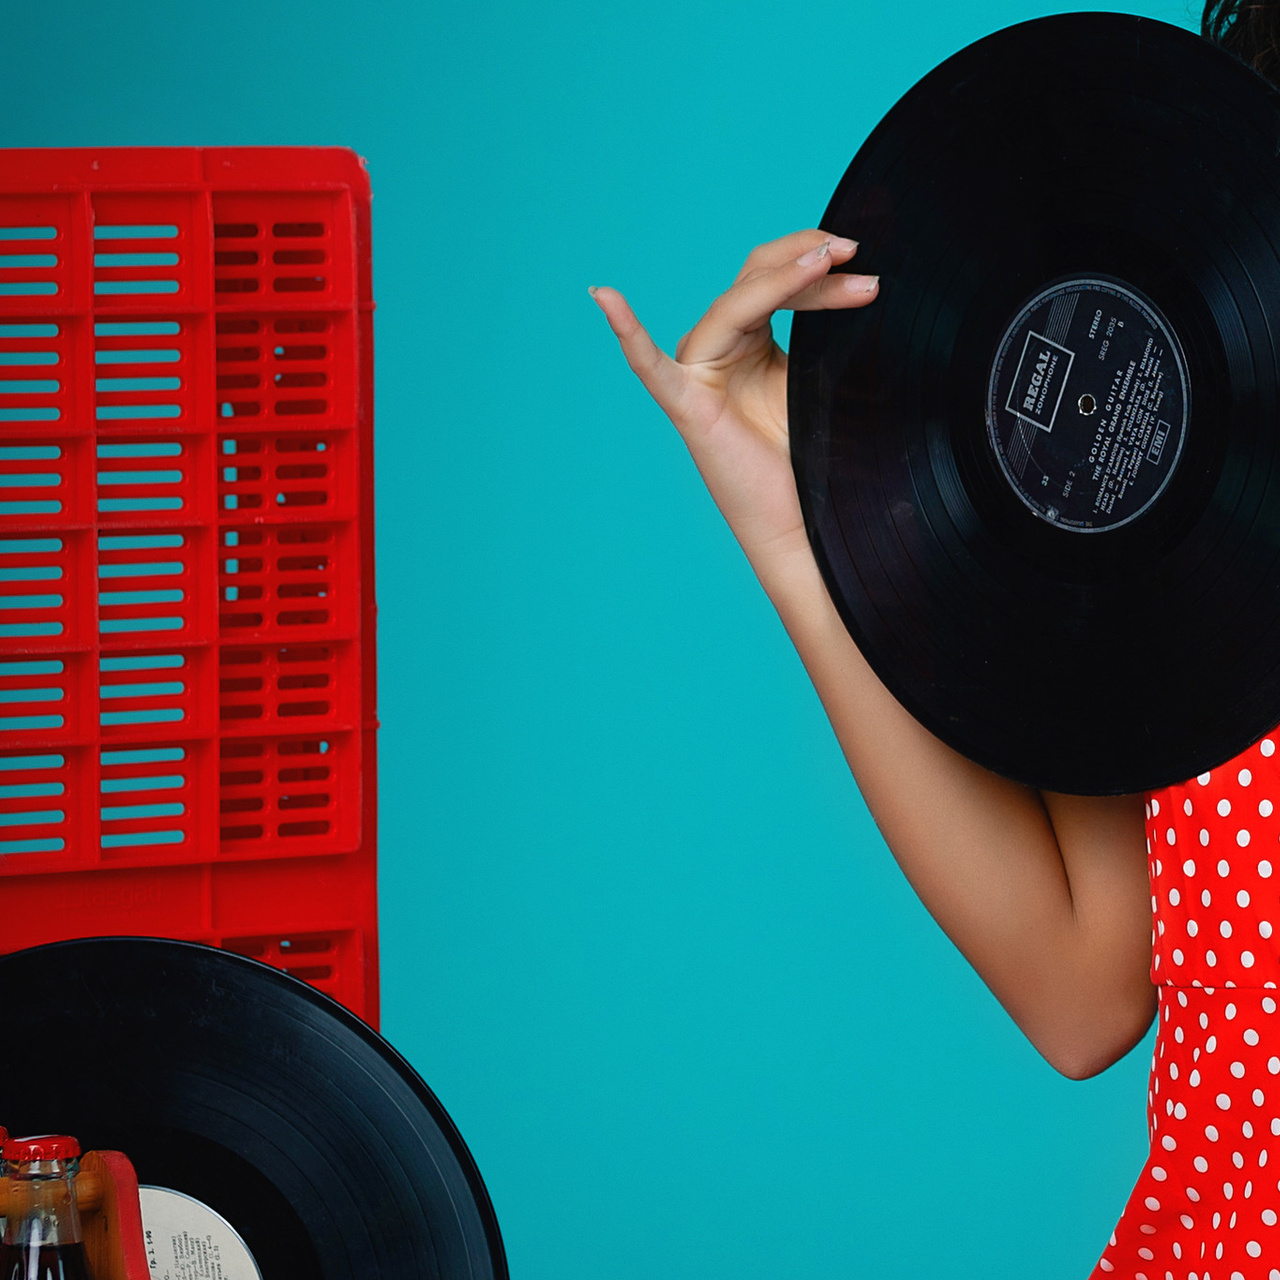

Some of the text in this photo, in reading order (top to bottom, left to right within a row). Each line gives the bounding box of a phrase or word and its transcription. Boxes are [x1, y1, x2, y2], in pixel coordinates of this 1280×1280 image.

[1088, 309, 1102, 339] STEREO
[1098, 316, 1116, 360] SREG 2035
[1022, 349, 1050, 411] REGAL
[1034, 354, 1058, 414] ZONOPHONE
[1088, 369, 1123, 463] GOLDEN GUITAR
[1094, 474, 1108, 506] ROMANCE
[1139, 337, 1153, 369] DIAMOND
[1097, 436, 1111, 463] ROYAL
[1107, 403, 1122, 432] GRAND
[1118, 360, 1136, 400] ENSEMBLE
[1128, 427, 1138, 445] VAYA
[1141, 389, 1150, 405] DIOS
[1131, 450, 1143, 478] JOHNNY
[1140, 424, 1152, 449] GUITAR
[1062, 479, 1072, 497] SIDE
[1100, 492, 1109, 510] HEAD
